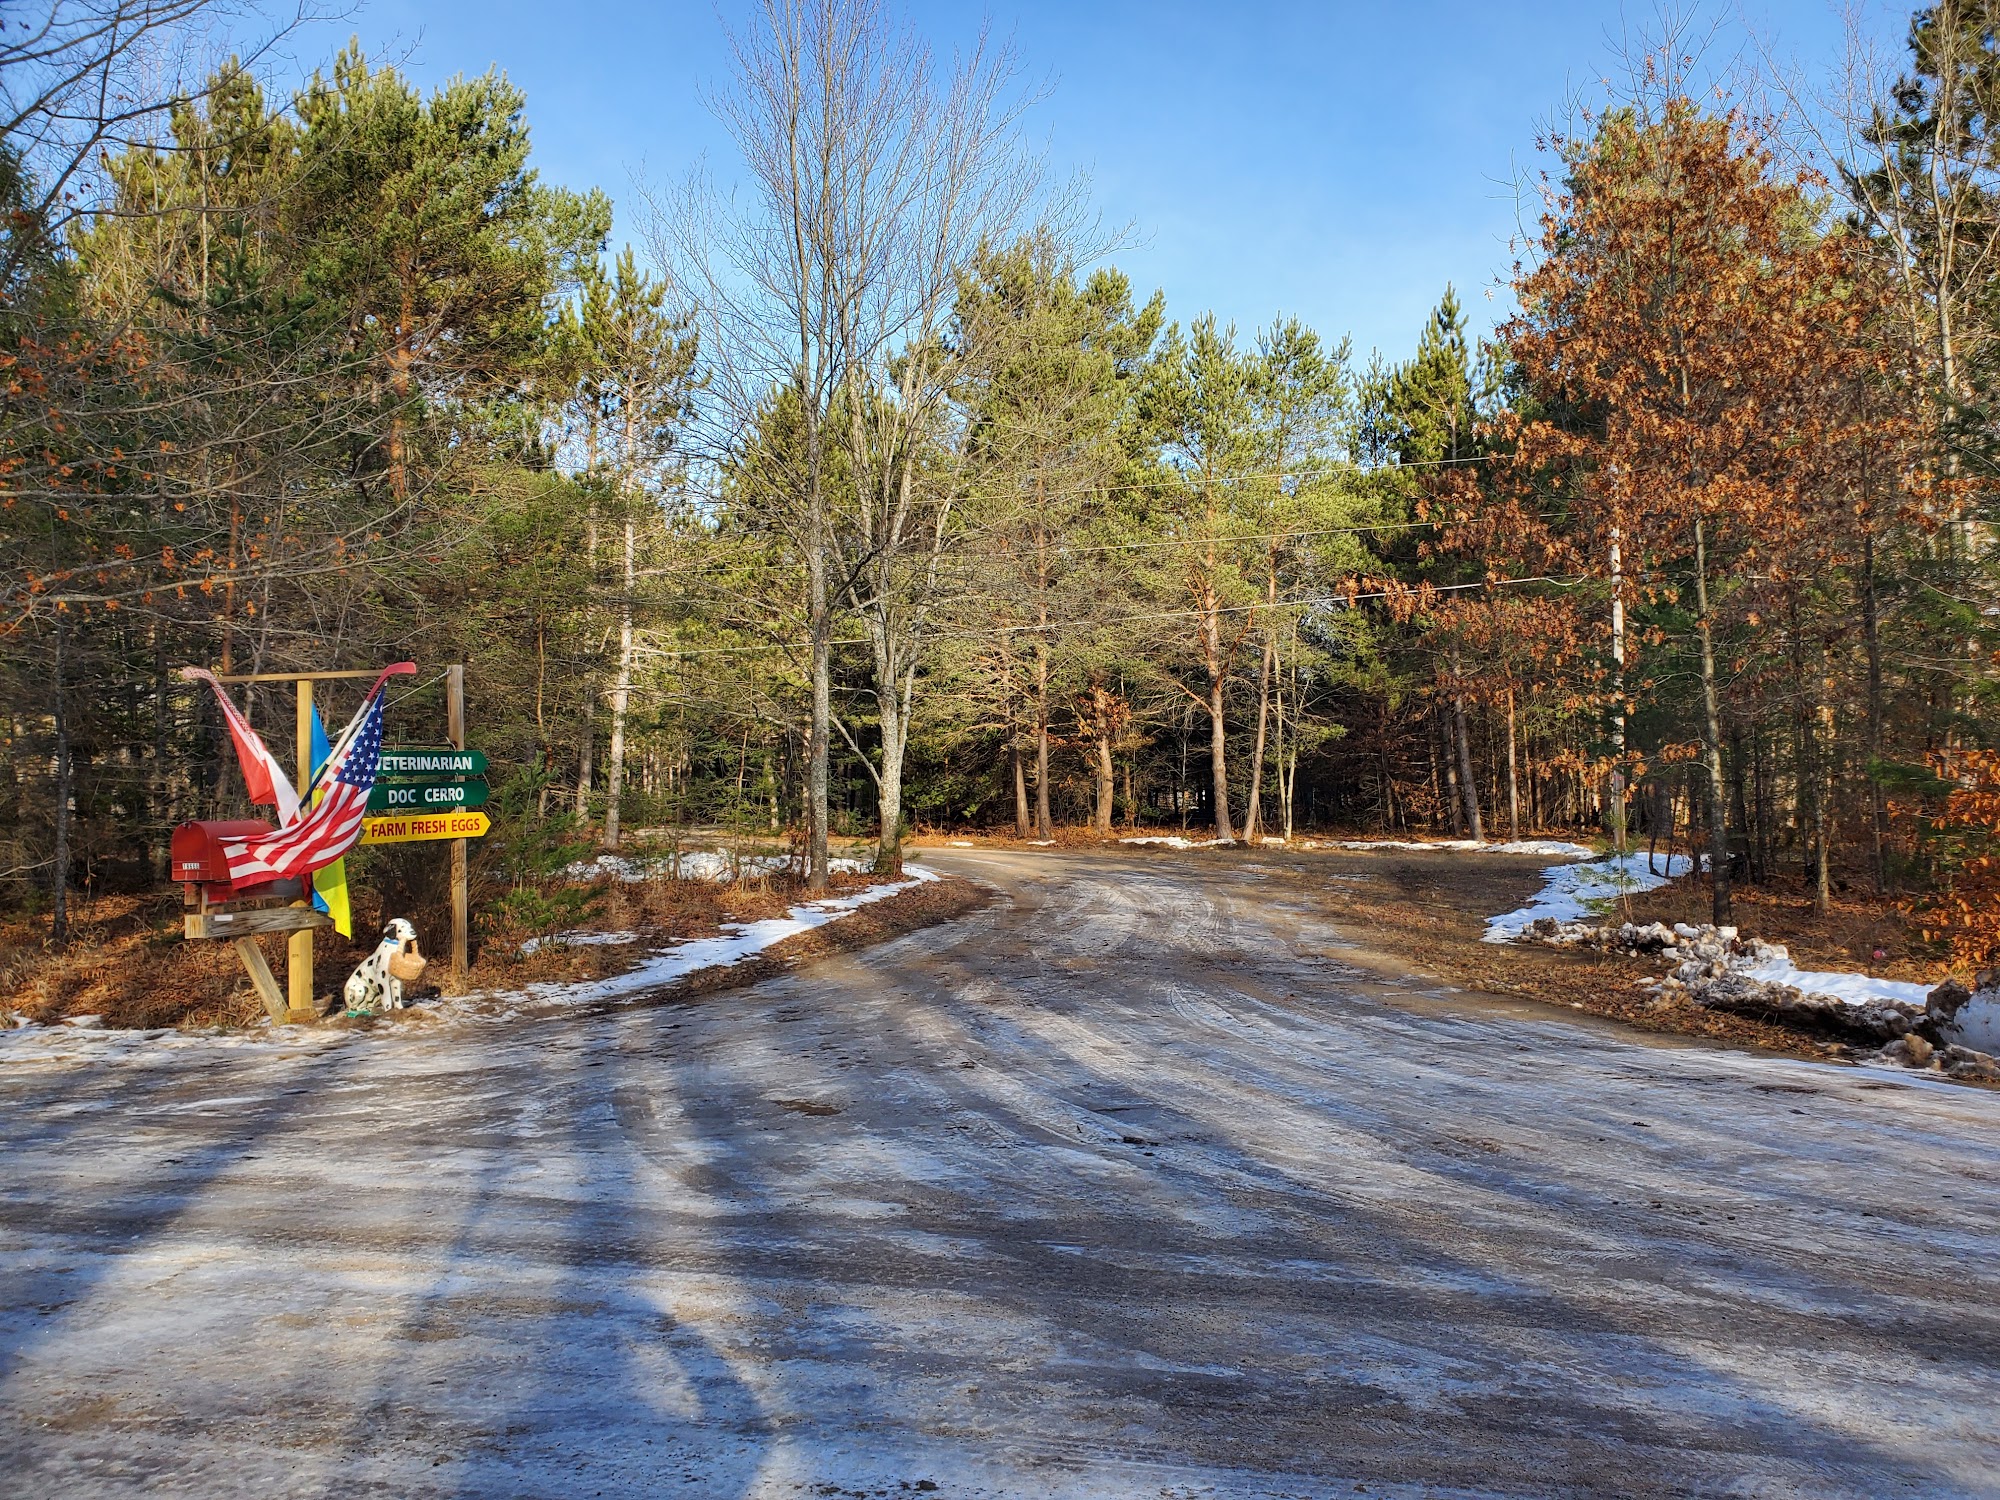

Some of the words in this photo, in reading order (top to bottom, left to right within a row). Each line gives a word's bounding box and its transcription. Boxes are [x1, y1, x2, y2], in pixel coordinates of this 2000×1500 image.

[388, 789, 417, 804] DOC
[424, 787, 464, 803] CERRO
[371, 822, 406, 838] FARM
[411, 820, 447, 835] FRESH
[451, 818, 480, 832] EGGS
